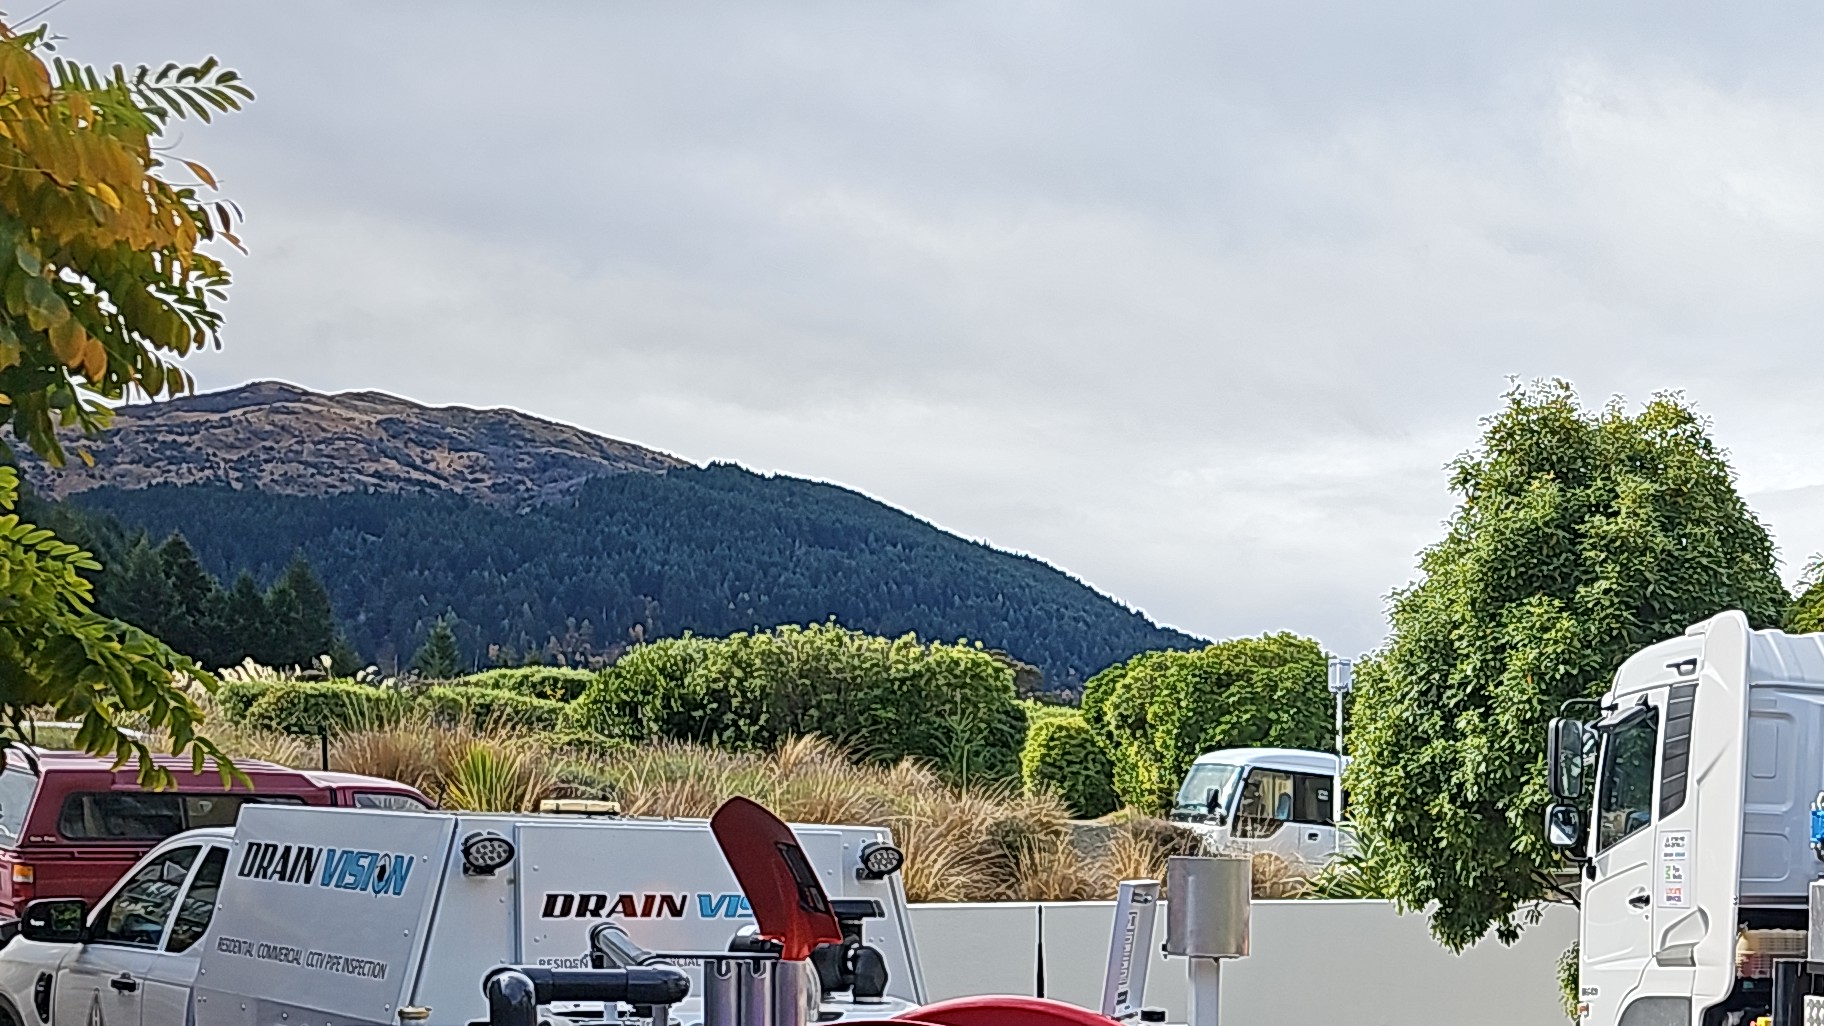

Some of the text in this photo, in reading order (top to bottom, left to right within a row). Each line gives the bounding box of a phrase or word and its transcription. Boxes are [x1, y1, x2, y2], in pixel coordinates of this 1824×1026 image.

[237, 841, 414, 897] DRAIN VISION
[542, 894, 755, 919] DRAIN VIS
[216, 936, 388, 980] RESIDENTIAL COMMERCIAL CCTV PIPE INSPECTION
[538, 958, 589, 969] RESIDEN
